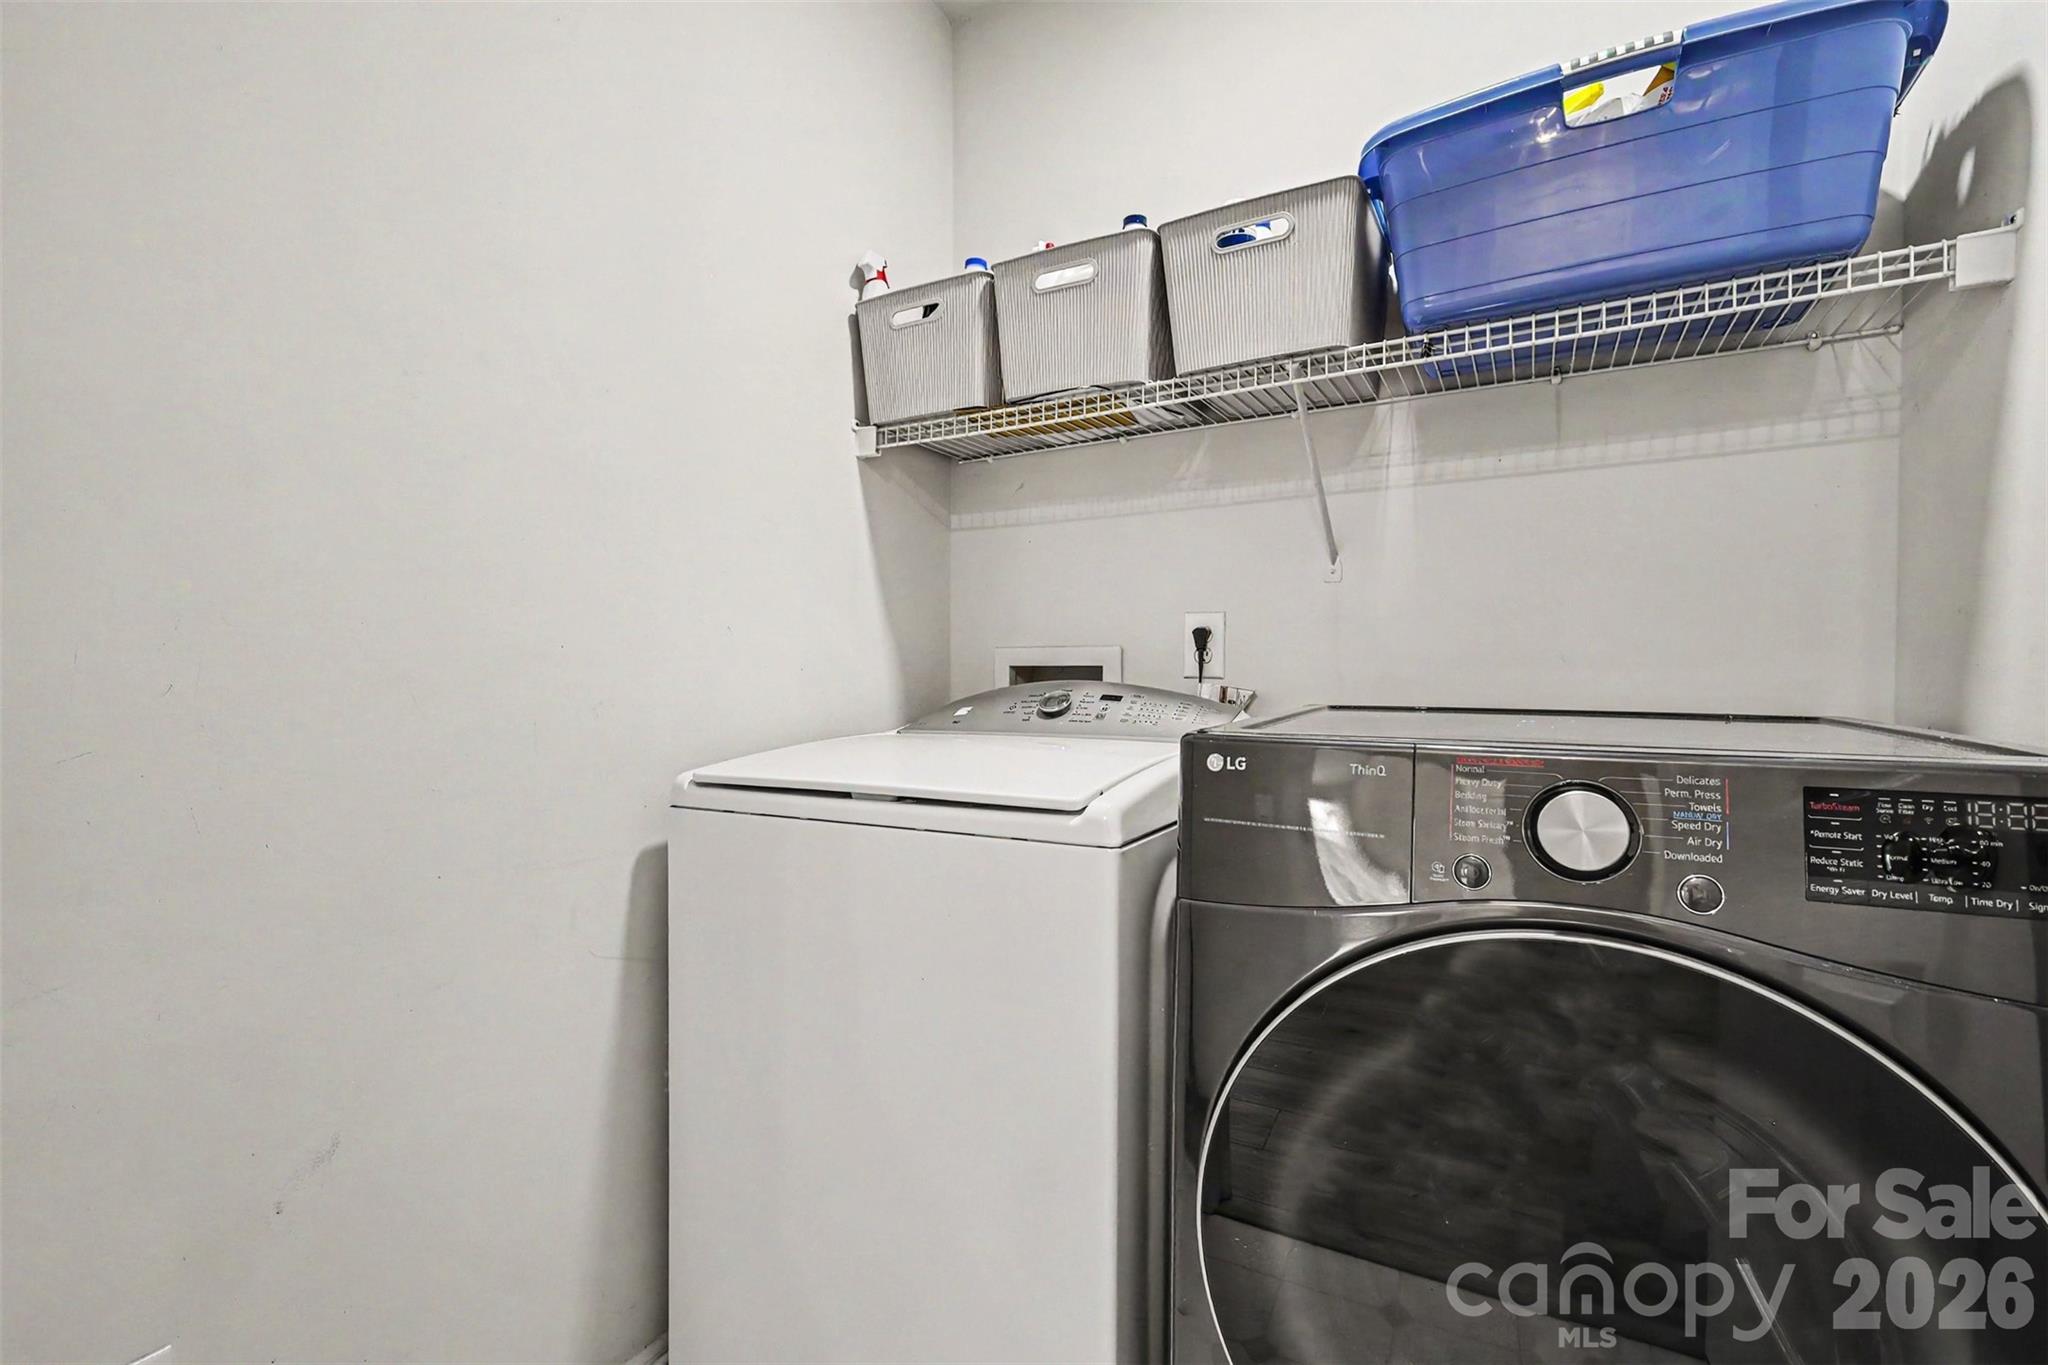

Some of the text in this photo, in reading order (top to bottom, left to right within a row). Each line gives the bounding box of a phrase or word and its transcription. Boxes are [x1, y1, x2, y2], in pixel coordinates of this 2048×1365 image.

[1225, 756, 1248, 771] LG
[1349, 763, 1388, 777] ThinQ
[1455, 764, 1485, 774] Normal
[1455, 777, 1503, 789] Heavy Duty
[1676, 775, 1721, 786] Delicates
[1664, 787, 1721, 800] Perm. Press
[1688, 802, 1722, 813] Towels
[1808, 801, 1861, 813] TurboStream
[1921, 804, 1935, 812] Dry
[1671, 820, 1722, 834] Speed Dry
[1453, 832, 1480, 843] Steam
[1843, 831, 1863, 841] Start
[1686, 836, 1723, 850] Air Dry
[1663, 850, 1723, 864] Downloaded
[1810, 855, 1864, 868] Reduce Static
[1810, 883, 1866, 897] Energy Saver
[1871, 888, 1914, 901] Dry Level
[1928, 893, 1954, 906] Temp
[1970, 896, 2014, 911] Time Dry
